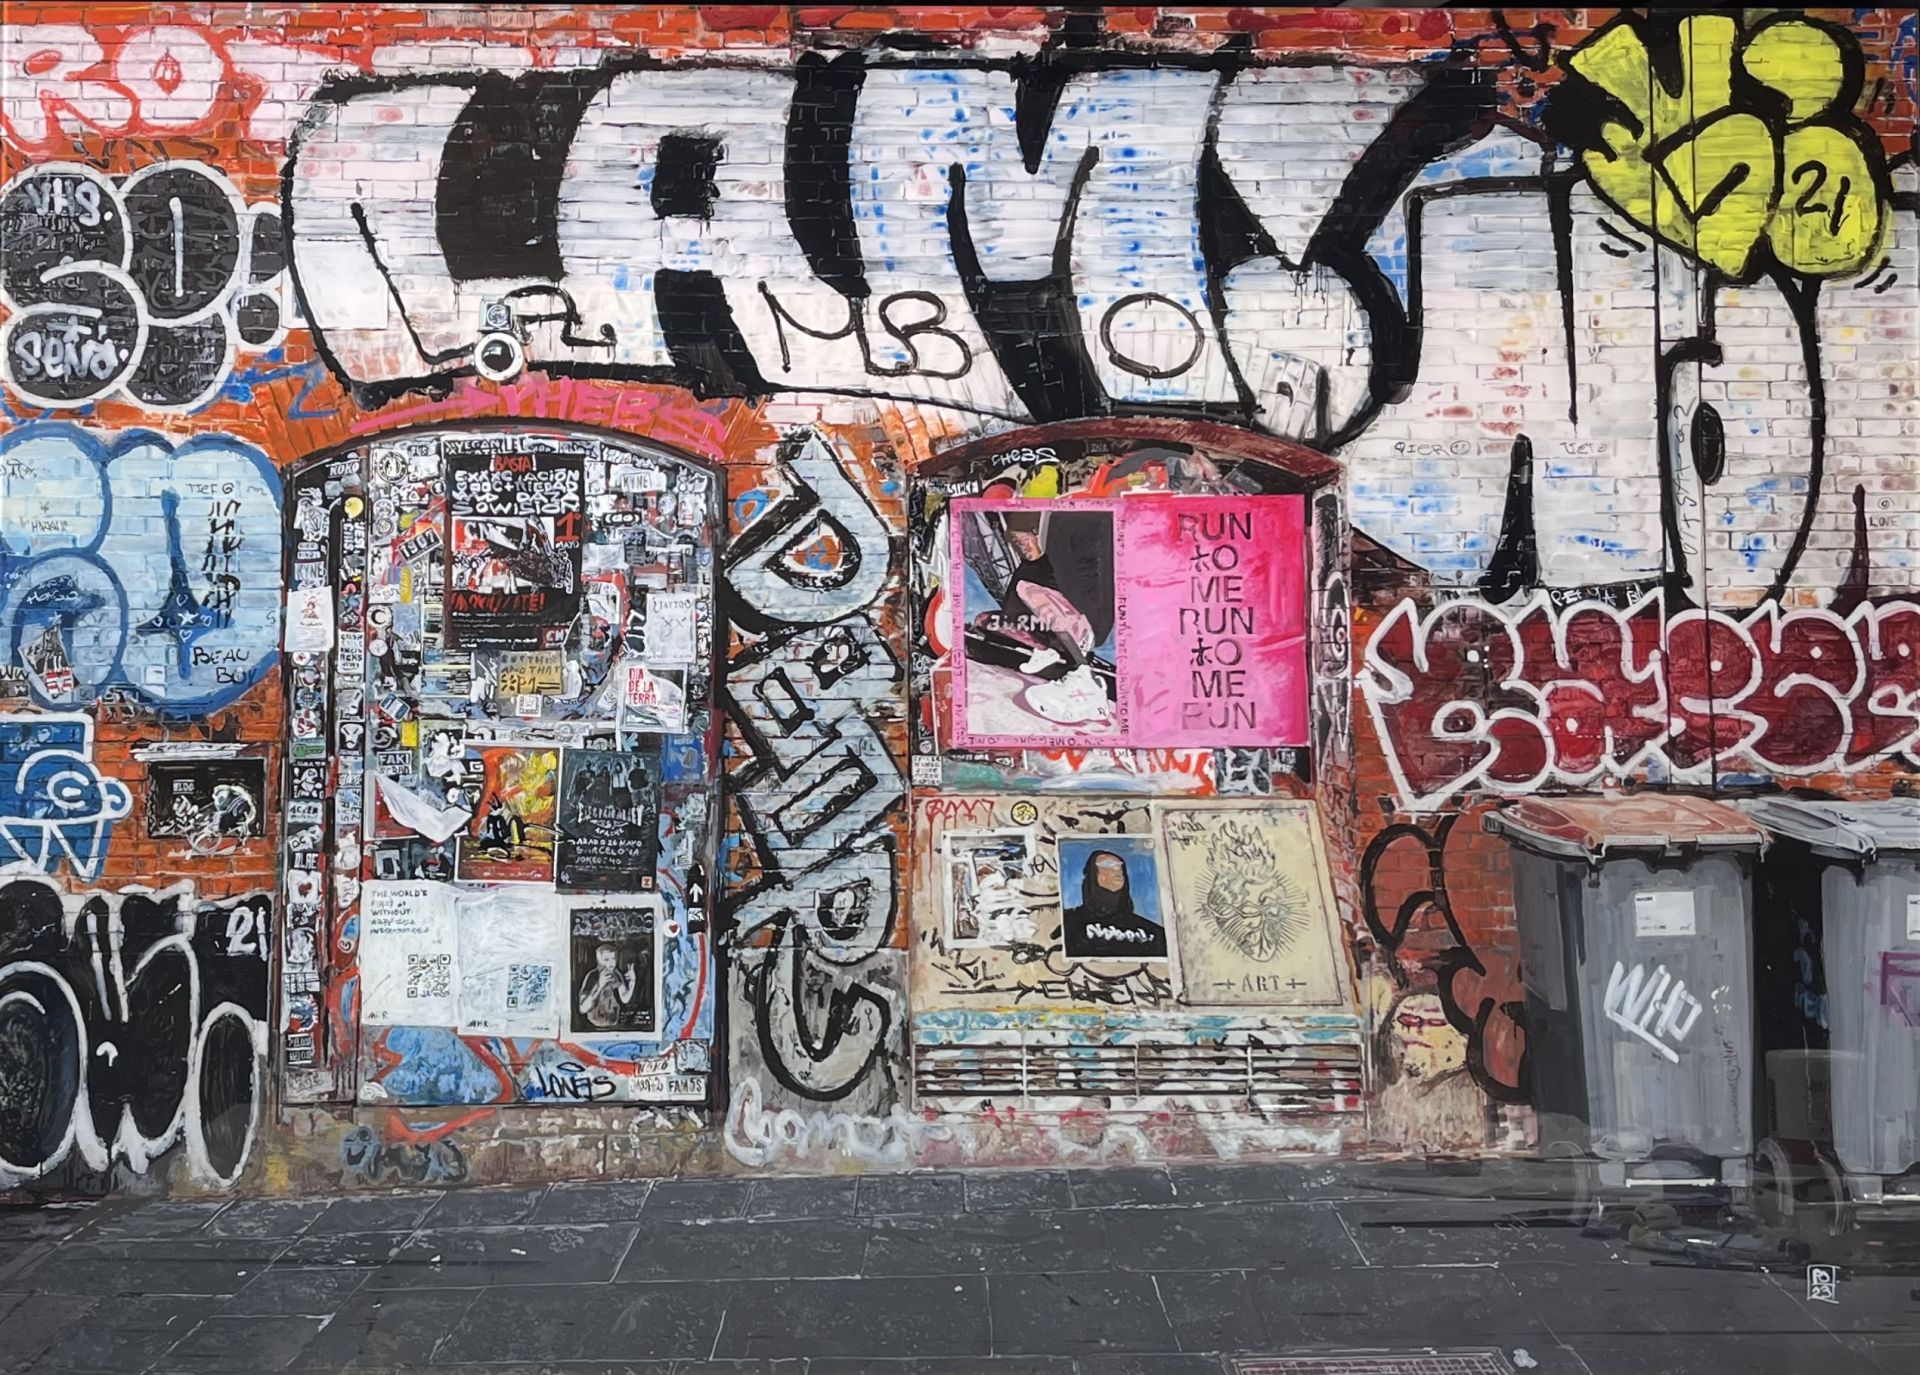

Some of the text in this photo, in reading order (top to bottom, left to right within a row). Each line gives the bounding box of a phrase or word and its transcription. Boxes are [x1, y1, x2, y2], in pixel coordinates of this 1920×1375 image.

[1792, 160, 1850, 237] 21
[1178, 512, 1252, 541] RUN
[402, 531, 437, 558] 1907
[1191, 575, 1243, 603] ME
[1179, 606, 1254, 635] RUN
[1192, 670, 1246, 698] ME
[1241, 975, 1281, 991] ART
